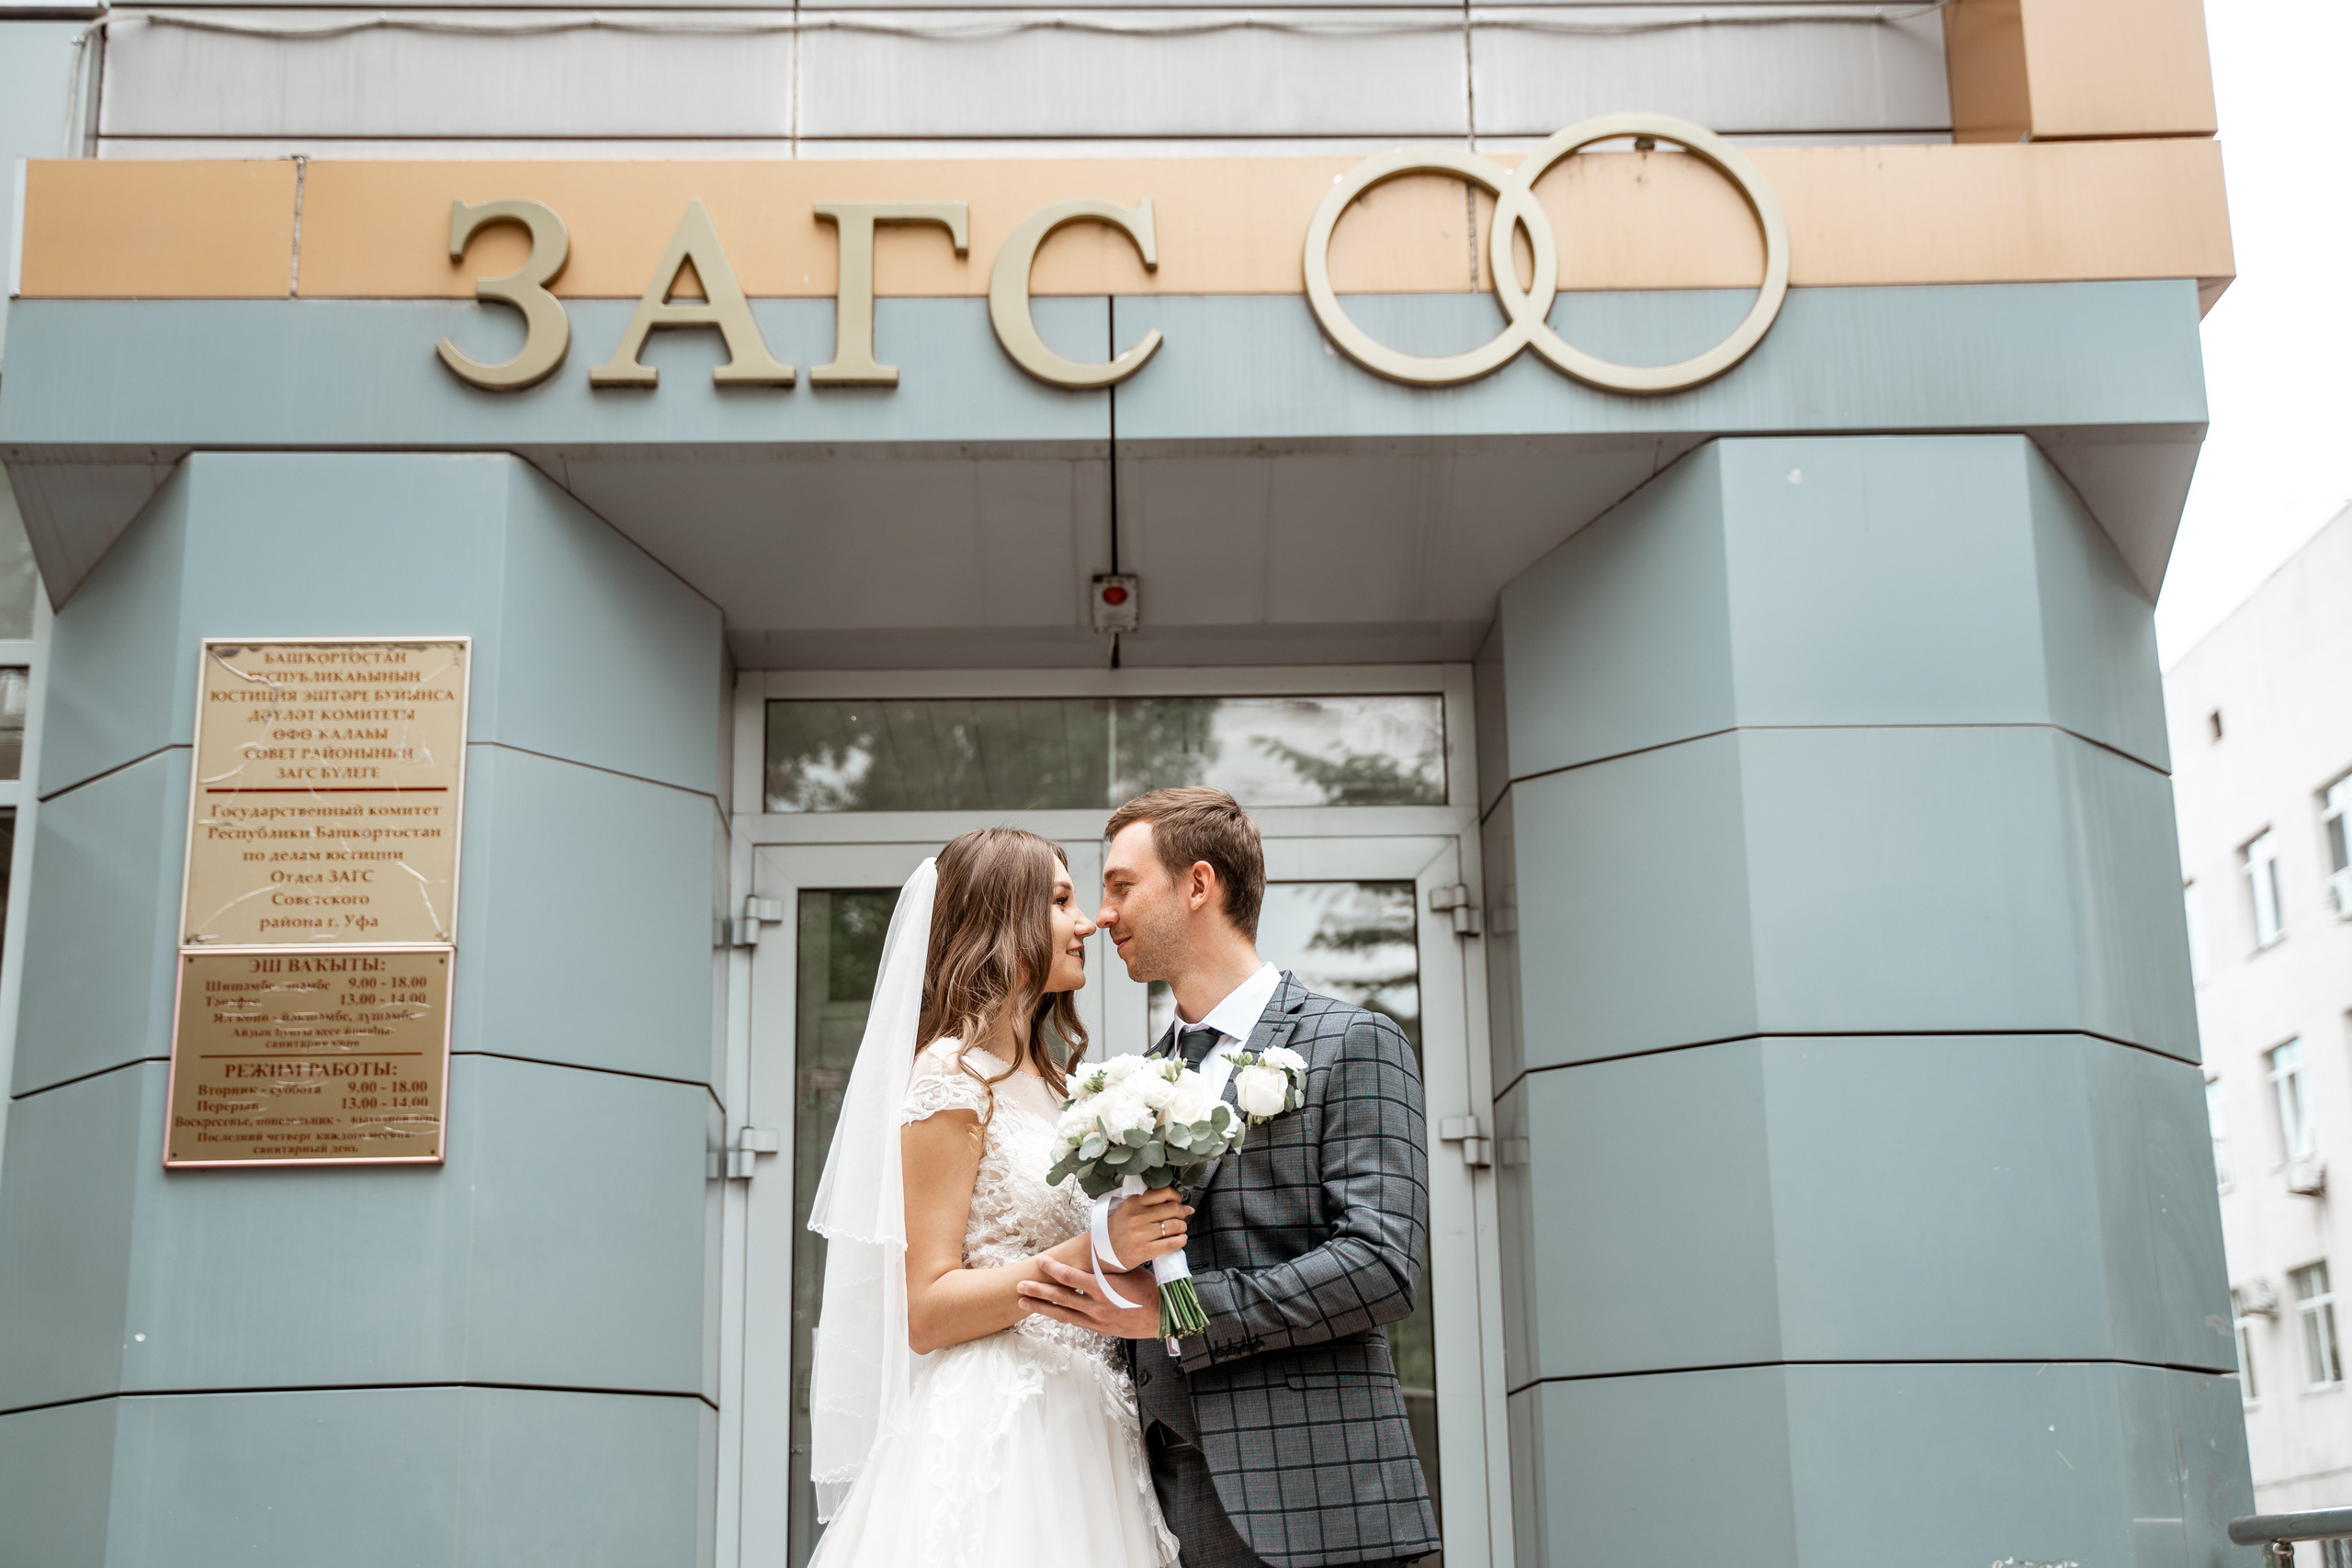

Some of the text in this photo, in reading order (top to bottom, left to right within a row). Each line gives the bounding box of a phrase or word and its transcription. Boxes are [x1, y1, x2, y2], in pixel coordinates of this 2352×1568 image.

[435, 197, 1164, 392] ЗАГС
[322, 708, 416, 722] КОМИТЕТЫ
[243, 748, 298, 761] СОВЕТ
[277, 767, 320, 780] ЗАГС
[210, 803, 441, 821] Государственный комитет
[208, 826, 442, 843] Республики Башкортостан
[243, 850, 404, 863] по делам юстиции
[270, 869, 375, 884] Отдел ЗАГС
[271, 892, 370, 907] Советского
[259, 913, 379, 931] района г. Уфа
[248, 958, 281, 974] ЭШ
[347, 976, 377, 990] 9.00
[390, 976, 427, 989] 18.00
[340, 993, 376, 1007] 13.00
[390, 993, 426, 1006] 14.00
[224, 1061, 398, 1078] РЕЖИМ РАБОТЫ:
[198, 1084, 258, 1098] Вторник
[269, 1084, 322, 1098] суббота
[347, 1081, 377, 1094] 9.00
[391, 1080, 427, 1094] 18.00
[197, 1100, 259, 1114] Перерыв
[342, 1097, 378, 1110] 13.00
[198, 1131, 264, 1144] Последний
[266, 1132, 312, 1144] четверг
[315, 1131, 366, 1142] каждого
[253, 1144, 359, 1156] санитарный день
